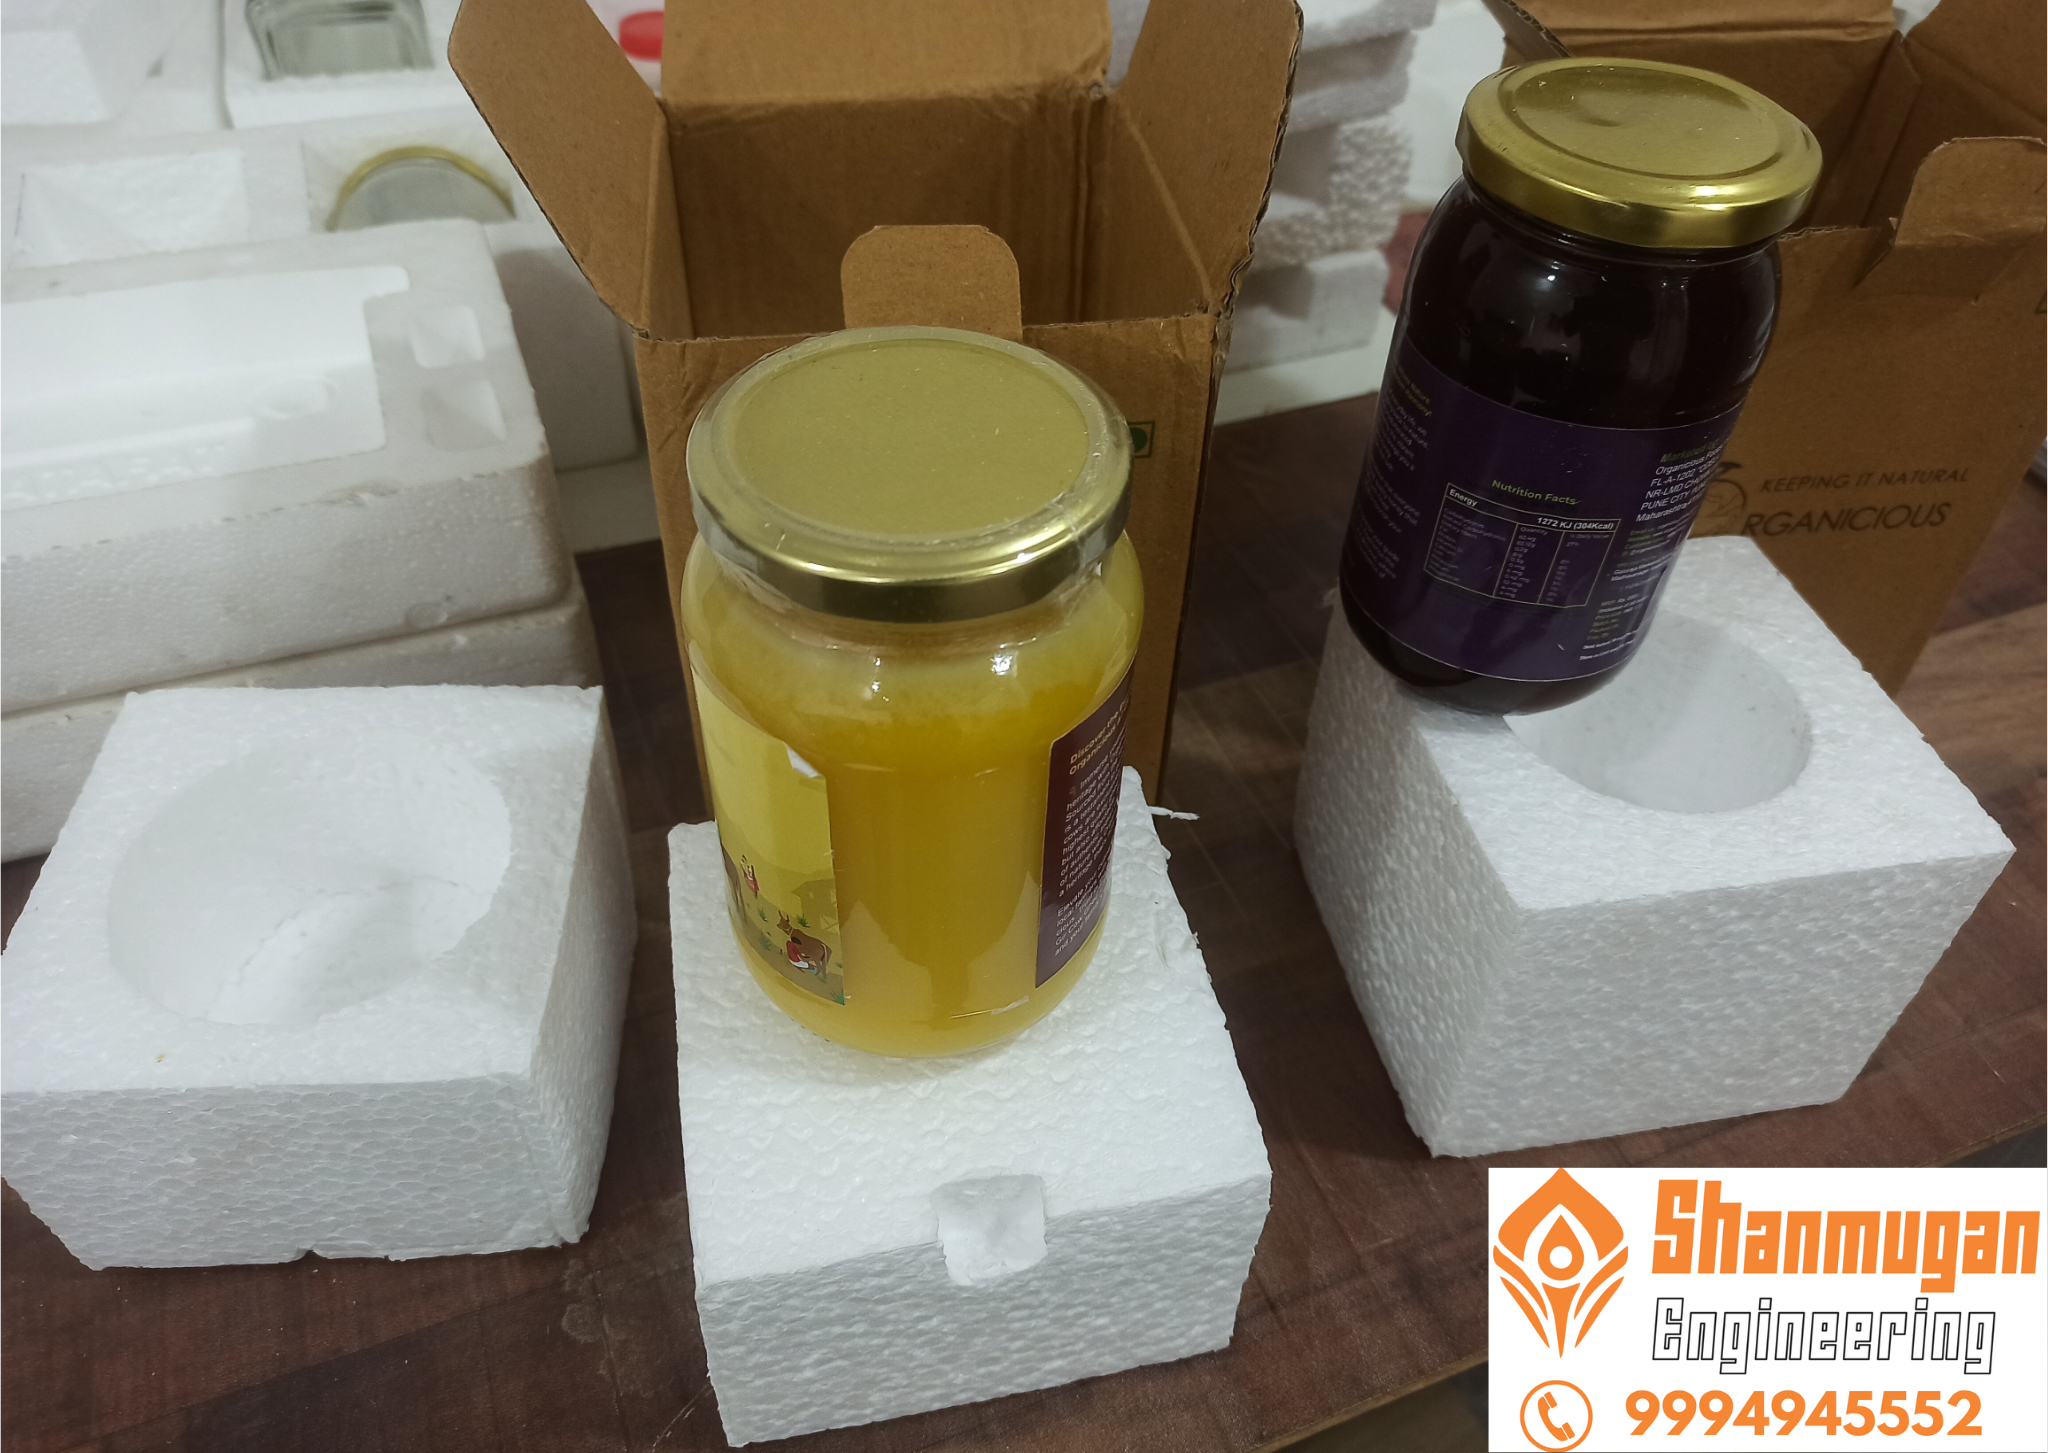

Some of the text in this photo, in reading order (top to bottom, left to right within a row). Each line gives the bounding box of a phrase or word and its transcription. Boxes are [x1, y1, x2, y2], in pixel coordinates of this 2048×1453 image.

[1656, 457, 1705, 475] Organicious
[1760, 467, 1969, 493] KEEPING IT NATURAL
[1449, 489, 1478, 507] Energy
[1492, 480, 1542, 501] Nutrition
[1545, 493, 1577, 505] Facts
[1640, 497, 1670, 510] PUNE
[1670, 490, 1691, 503] CITY
[1520, 527, 1549, 536] Quantity
[1537, 517, 1557, 528] 1272
[1559, 520, 1572, 529] KJ
[1070, 726, 1106, 764] Discover
[1107, 711, 1119, 728] the
[1070, 724, 1116, 775] Organicious
[1065, 788, 1097, 822] Sourced
[1073, 818, 1078, 826] a
[1063, 826, 1089, 855] highest
[1064, 824, 1083, 844] cows
[1061, 851, 1074, 866] but
[1059, 889, 1064, 898] a
[1066, 859, 1092, 891] heritage
[1060, 874, 1068, 886] of
[1070, 853, 1091, 879] nature
[1061, 864, 1069, 876] of
[1058, 889, 1084, 917] Elevate
[1068, 917, 1082, 934] Cow
[1055, 939, 1069, 956] and
